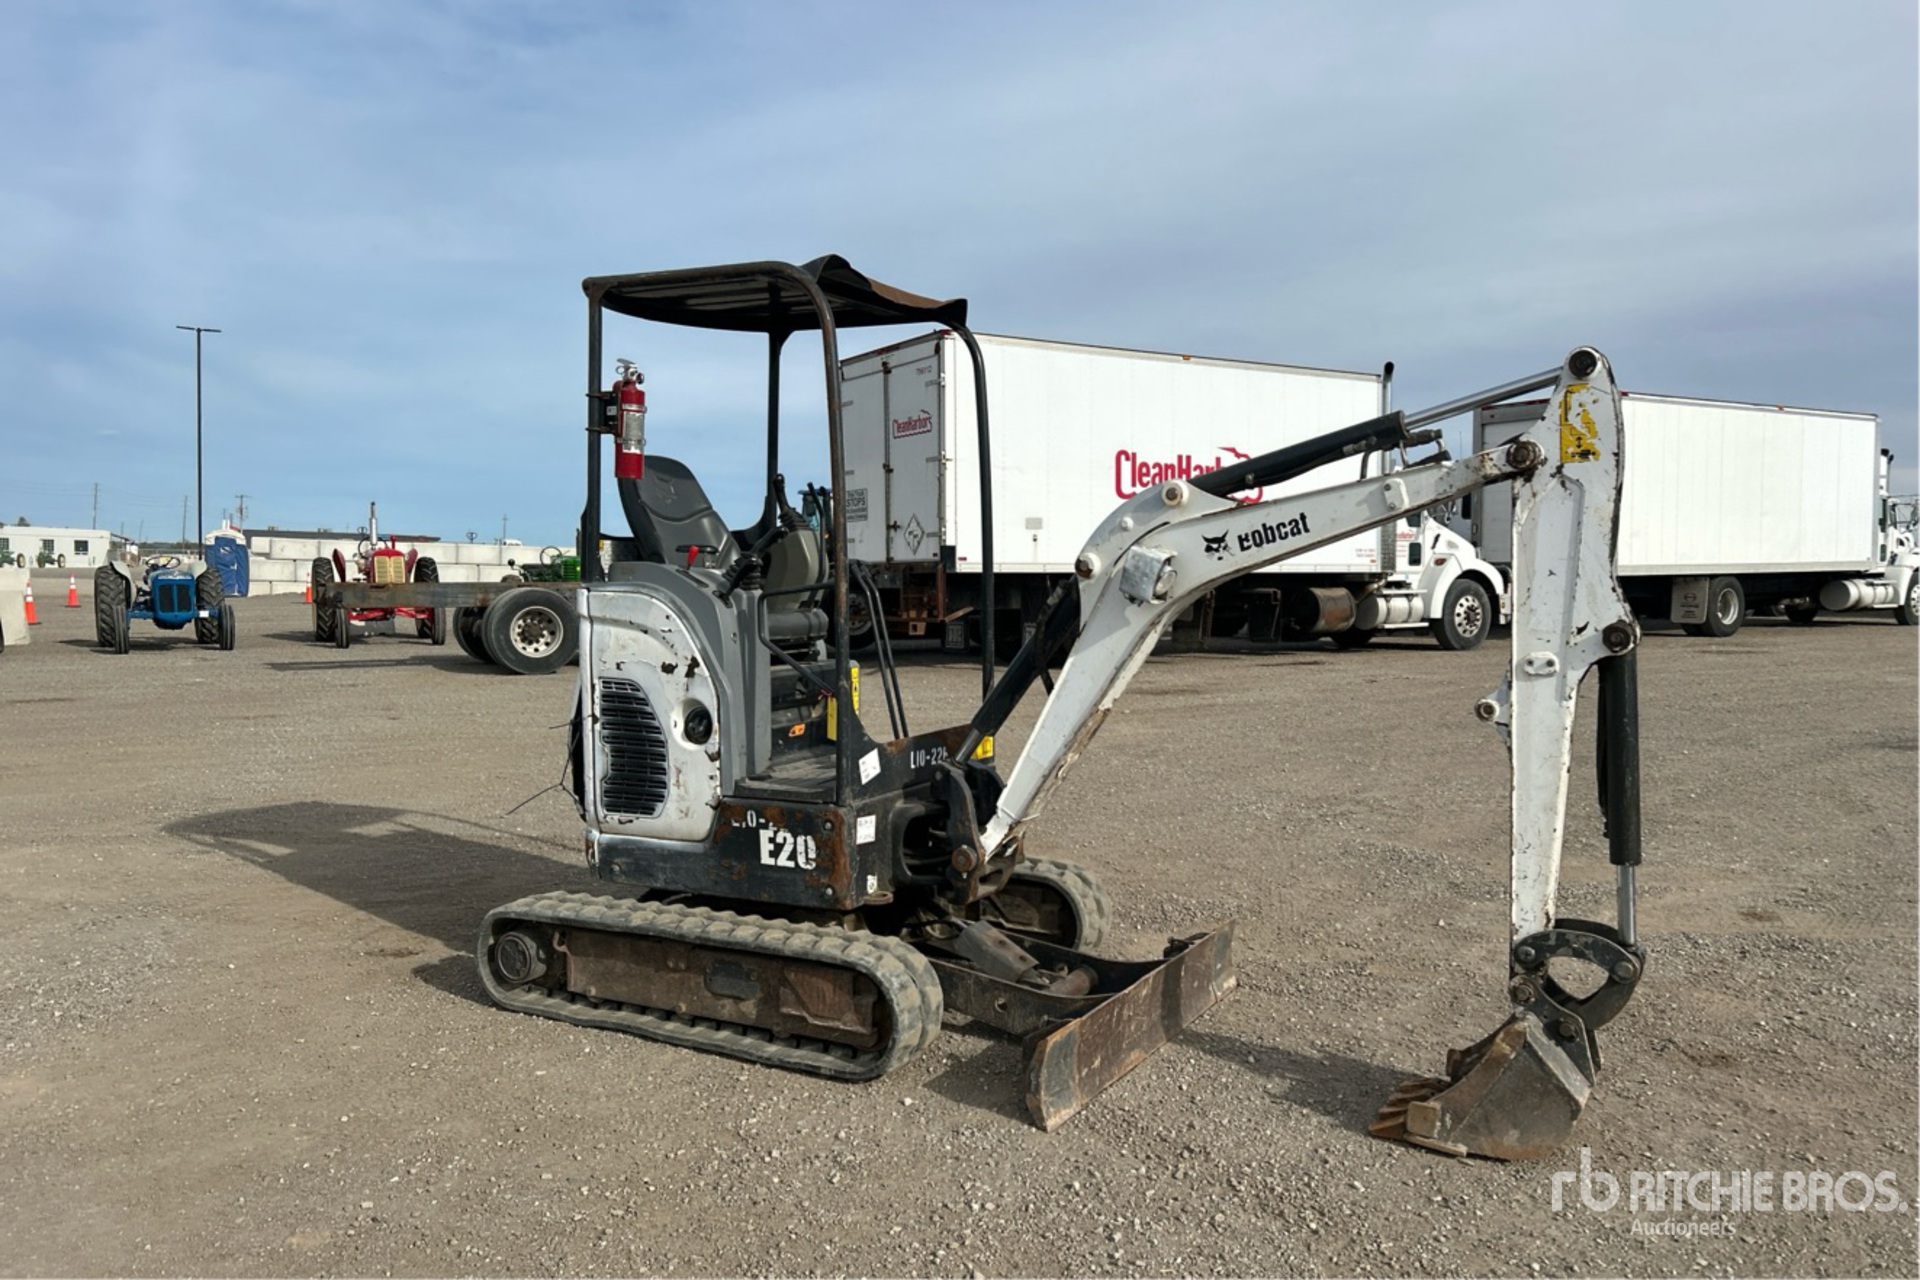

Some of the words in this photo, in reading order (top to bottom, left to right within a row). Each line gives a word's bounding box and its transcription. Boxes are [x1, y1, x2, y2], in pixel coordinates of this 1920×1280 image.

[1115, 447, 1263, 504] CleanHa
[1237, 512, 1310, 552] Bobcat
[759, 829, 817, 870] E20
